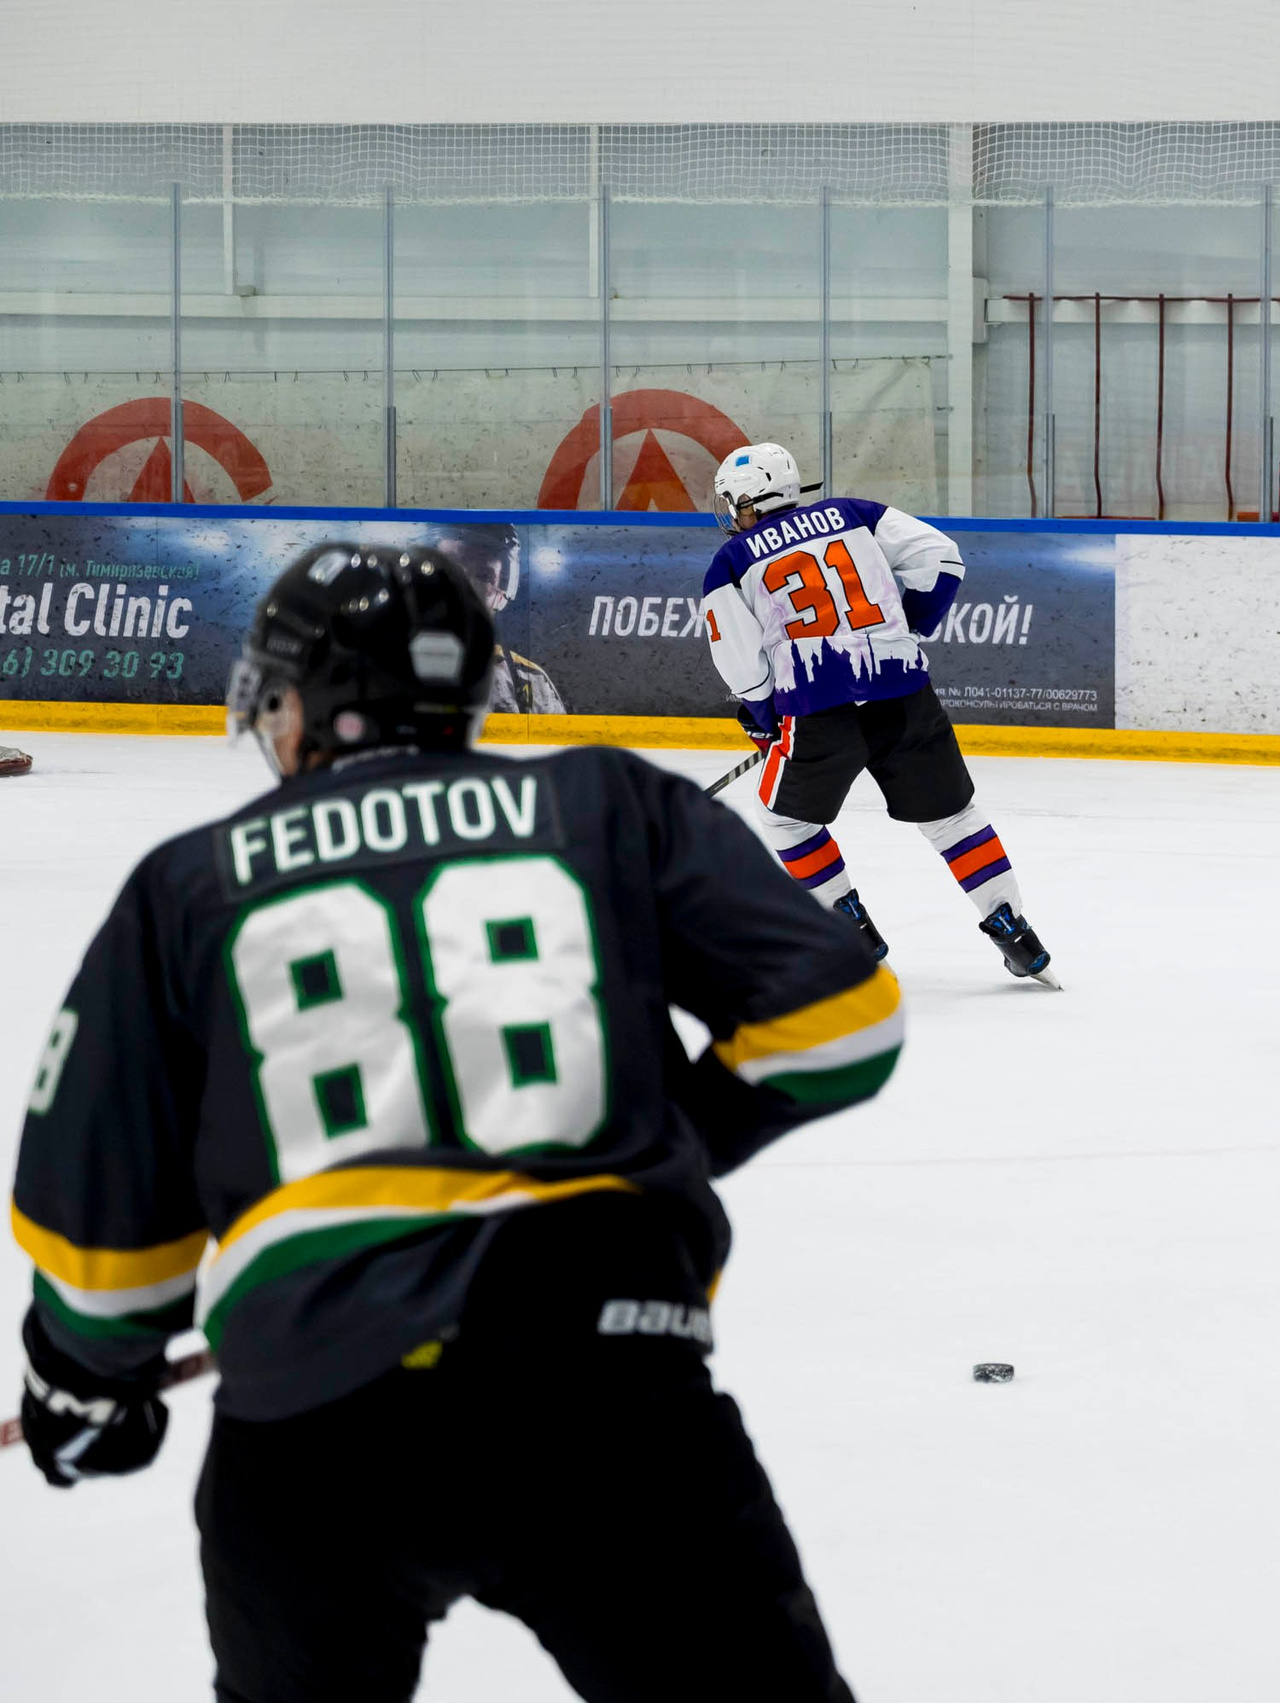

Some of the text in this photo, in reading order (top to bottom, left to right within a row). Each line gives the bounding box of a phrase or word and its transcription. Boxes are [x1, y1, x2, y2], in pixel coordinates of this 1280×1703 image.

[746, 507, 846, 559] ИВАНОВ
[19, 553, 55, 578] 17/1
[763, 540, 886, 639] 31
[64, 582, 193, 639] Clinic
[40, 649, 95, 677] 309
[103, 651, 140, 679] 30
[150, 651, 185, 680] 93
[1061, 703, 1098, 712] ВРАЧОМ
[230, 775, 539, 886] FEDOTOV
[225, 856, 608, 1186] 88
